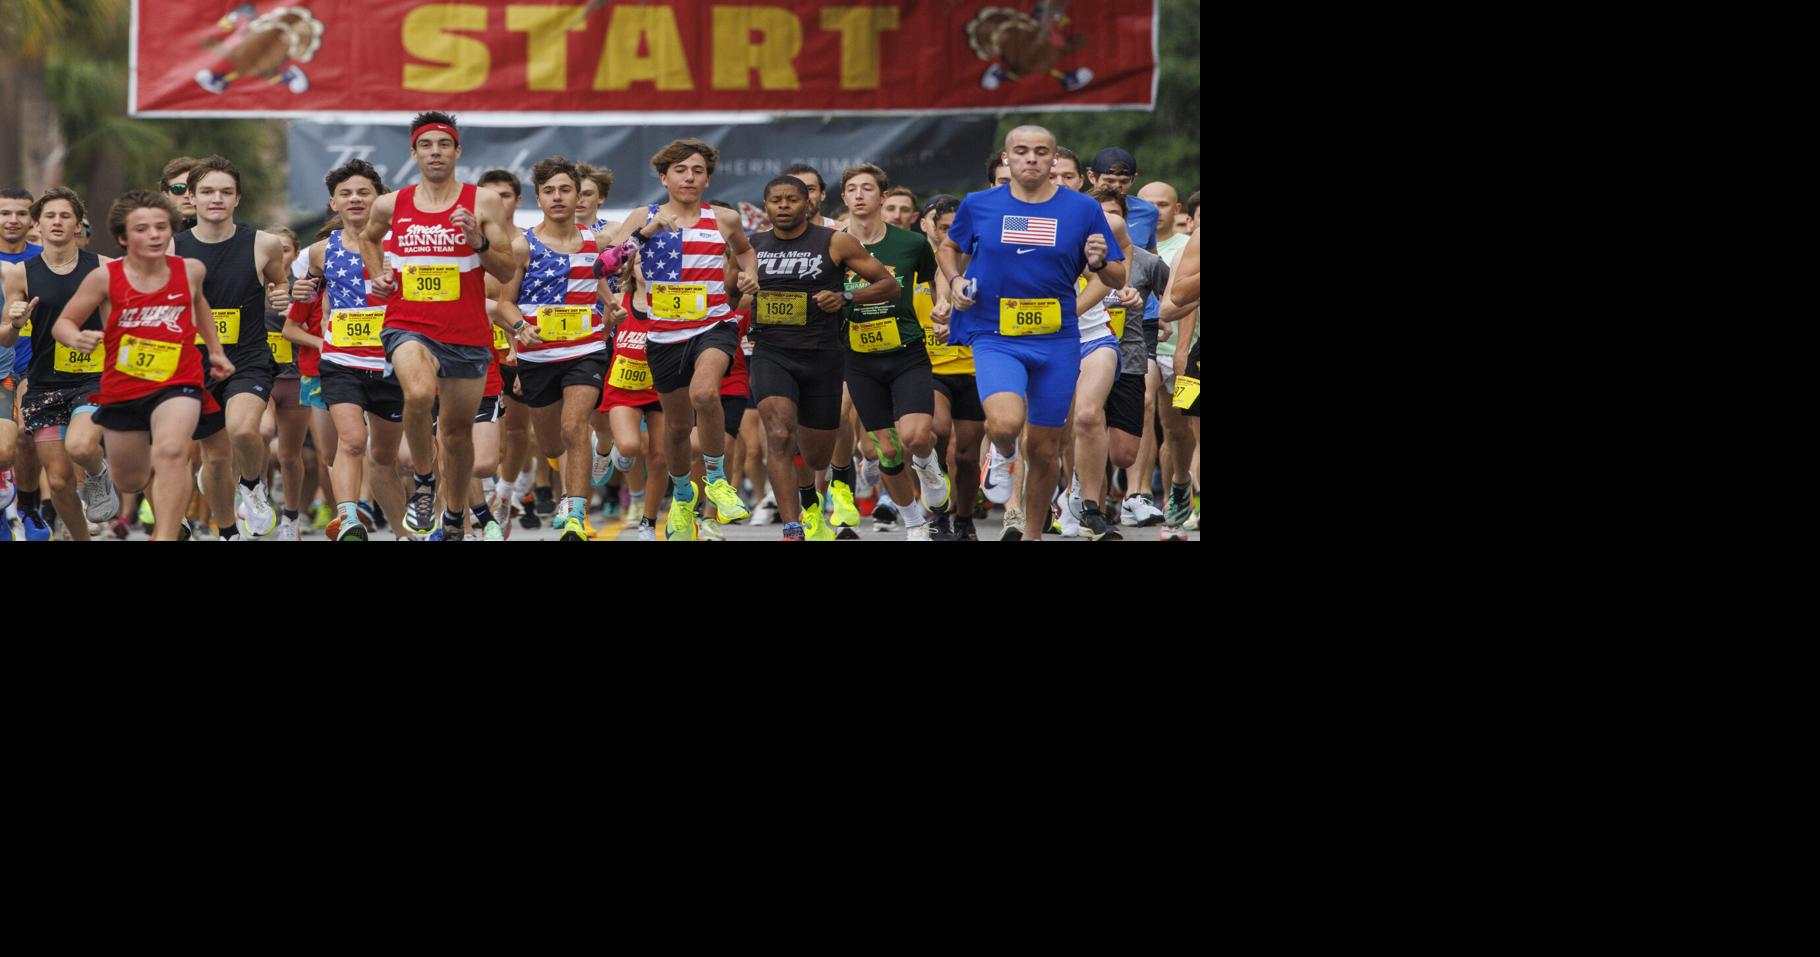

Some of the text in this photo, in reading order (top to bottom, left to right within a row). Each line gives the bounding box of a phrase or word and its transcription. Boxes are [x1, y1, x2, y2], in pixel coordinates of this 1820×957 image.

[402, 4, 899, 93] START
[398, 233, 466, 247] RUNNING
[757, 250, 811, 259] Black Men
[757, 257, 809, 275] run
[417, 277, 441, 291] 309
[673, 296, 681, 309] 3
[766, 303, 793, 315] 1502
[561, 318, 567, 331] 1
[1016, 312, 1042, 325] 686
[347, 323, 370, 336] 594
[860, 331, 883, 345] 654
[69, 351, 91, 364] 844
[136, 352, 155, 368] 37
[621, 368, 646, 382] 1090
